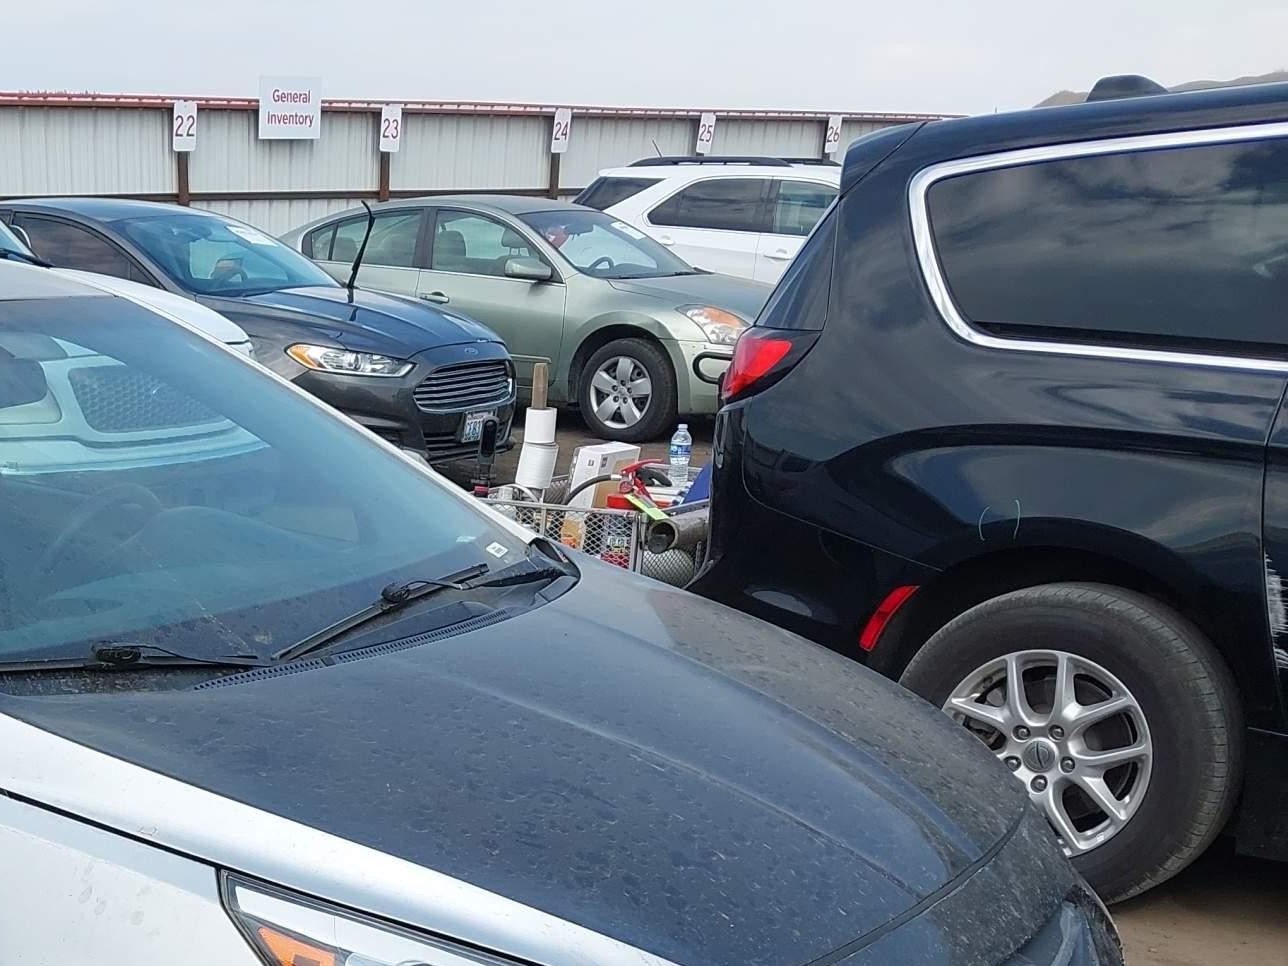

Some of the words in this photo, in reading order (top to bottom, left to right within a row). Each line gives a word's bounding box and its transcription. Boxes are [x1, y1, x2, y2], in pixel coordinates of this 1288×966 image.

[272, 89, 311, 104] General
[175, 115, 195, 137] 22
[267, 110, 314, 128] Inventory
[382, 118, 399, 139] 23
[554, 121, 569, 141] 24
[699, 123, 713, 143] 25
[826, 126, 840, 143] 26
